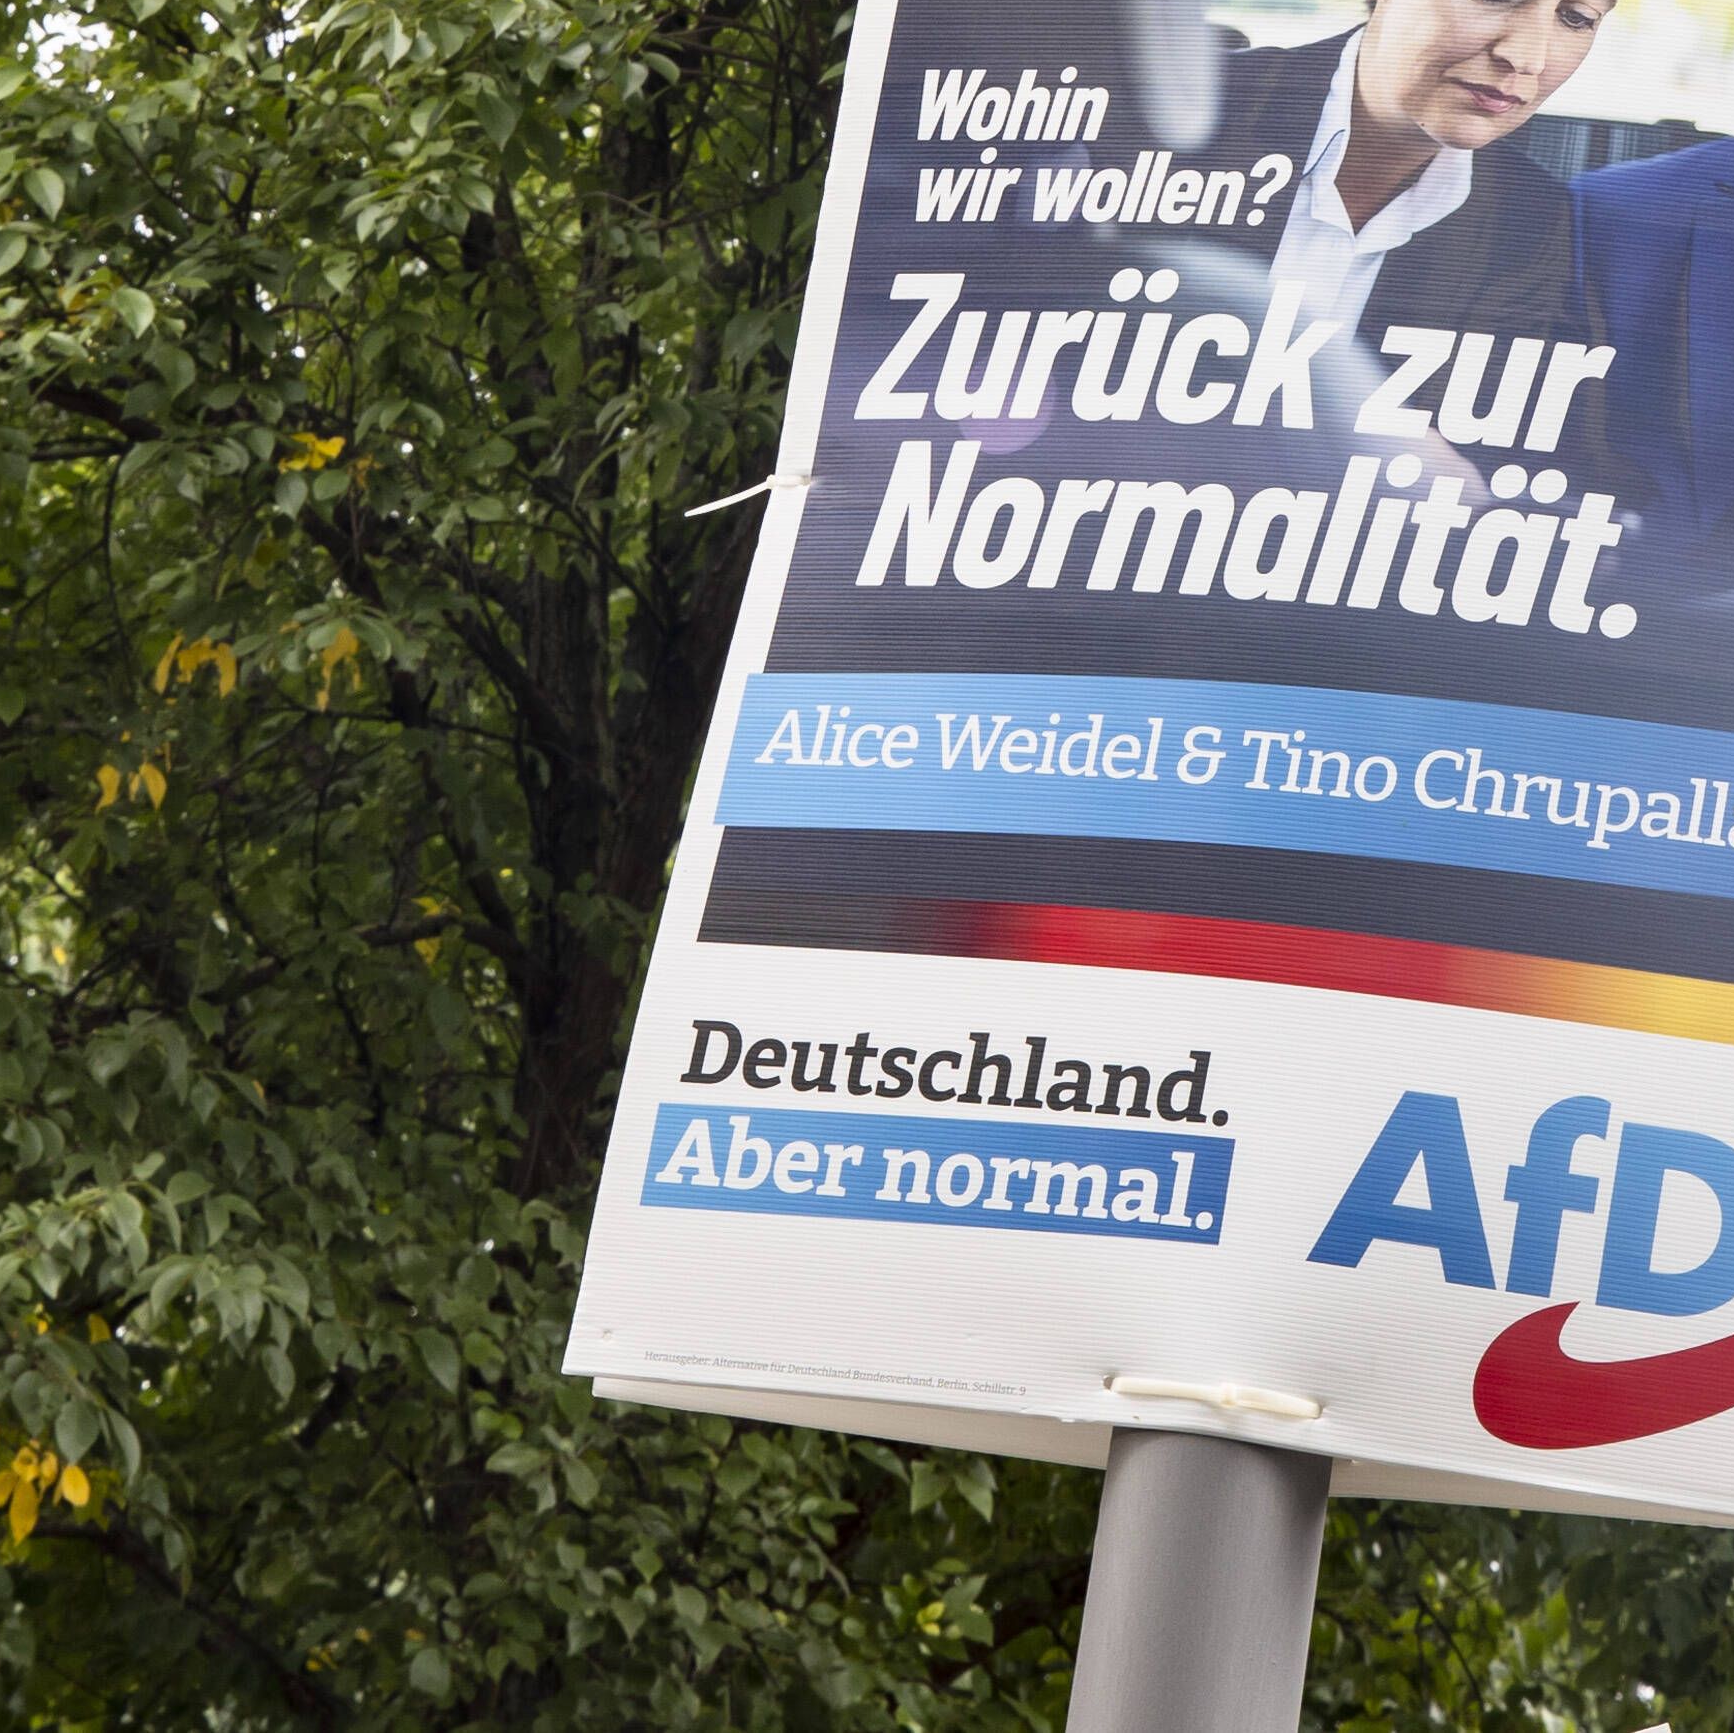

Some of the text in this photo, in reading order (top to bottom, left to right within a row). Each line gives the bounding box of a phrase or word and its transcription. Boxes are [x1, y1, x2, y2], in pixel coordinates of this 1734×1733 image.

[917, 67, 1109, 141] Wohin
[915, 147, 1293, 226] wir wollen?
[853, 268, 1617, 452] Zurück zur
[855, 439, 1638, 639] Normalität.
[754, 706, 918, 769] Alice
[935, 712, 1162, 782] Weidel
[1177, 721, 1227, 786] &
[1243, 729, 1399, 802] Tino
[680, 1019, 1229, 1127] Deutschland.
[655, 1116, 1214, 1230] Aber normal.
[713, 1357, 768, 1371] Alternative
[787, 1364, 851, 1379] Deutschland
[853, 1370, 934, 1388] Bundesverband,
[936, 1377, 970, 1391] Berlin,
[1019, 1386, 1027, 1396] 9
